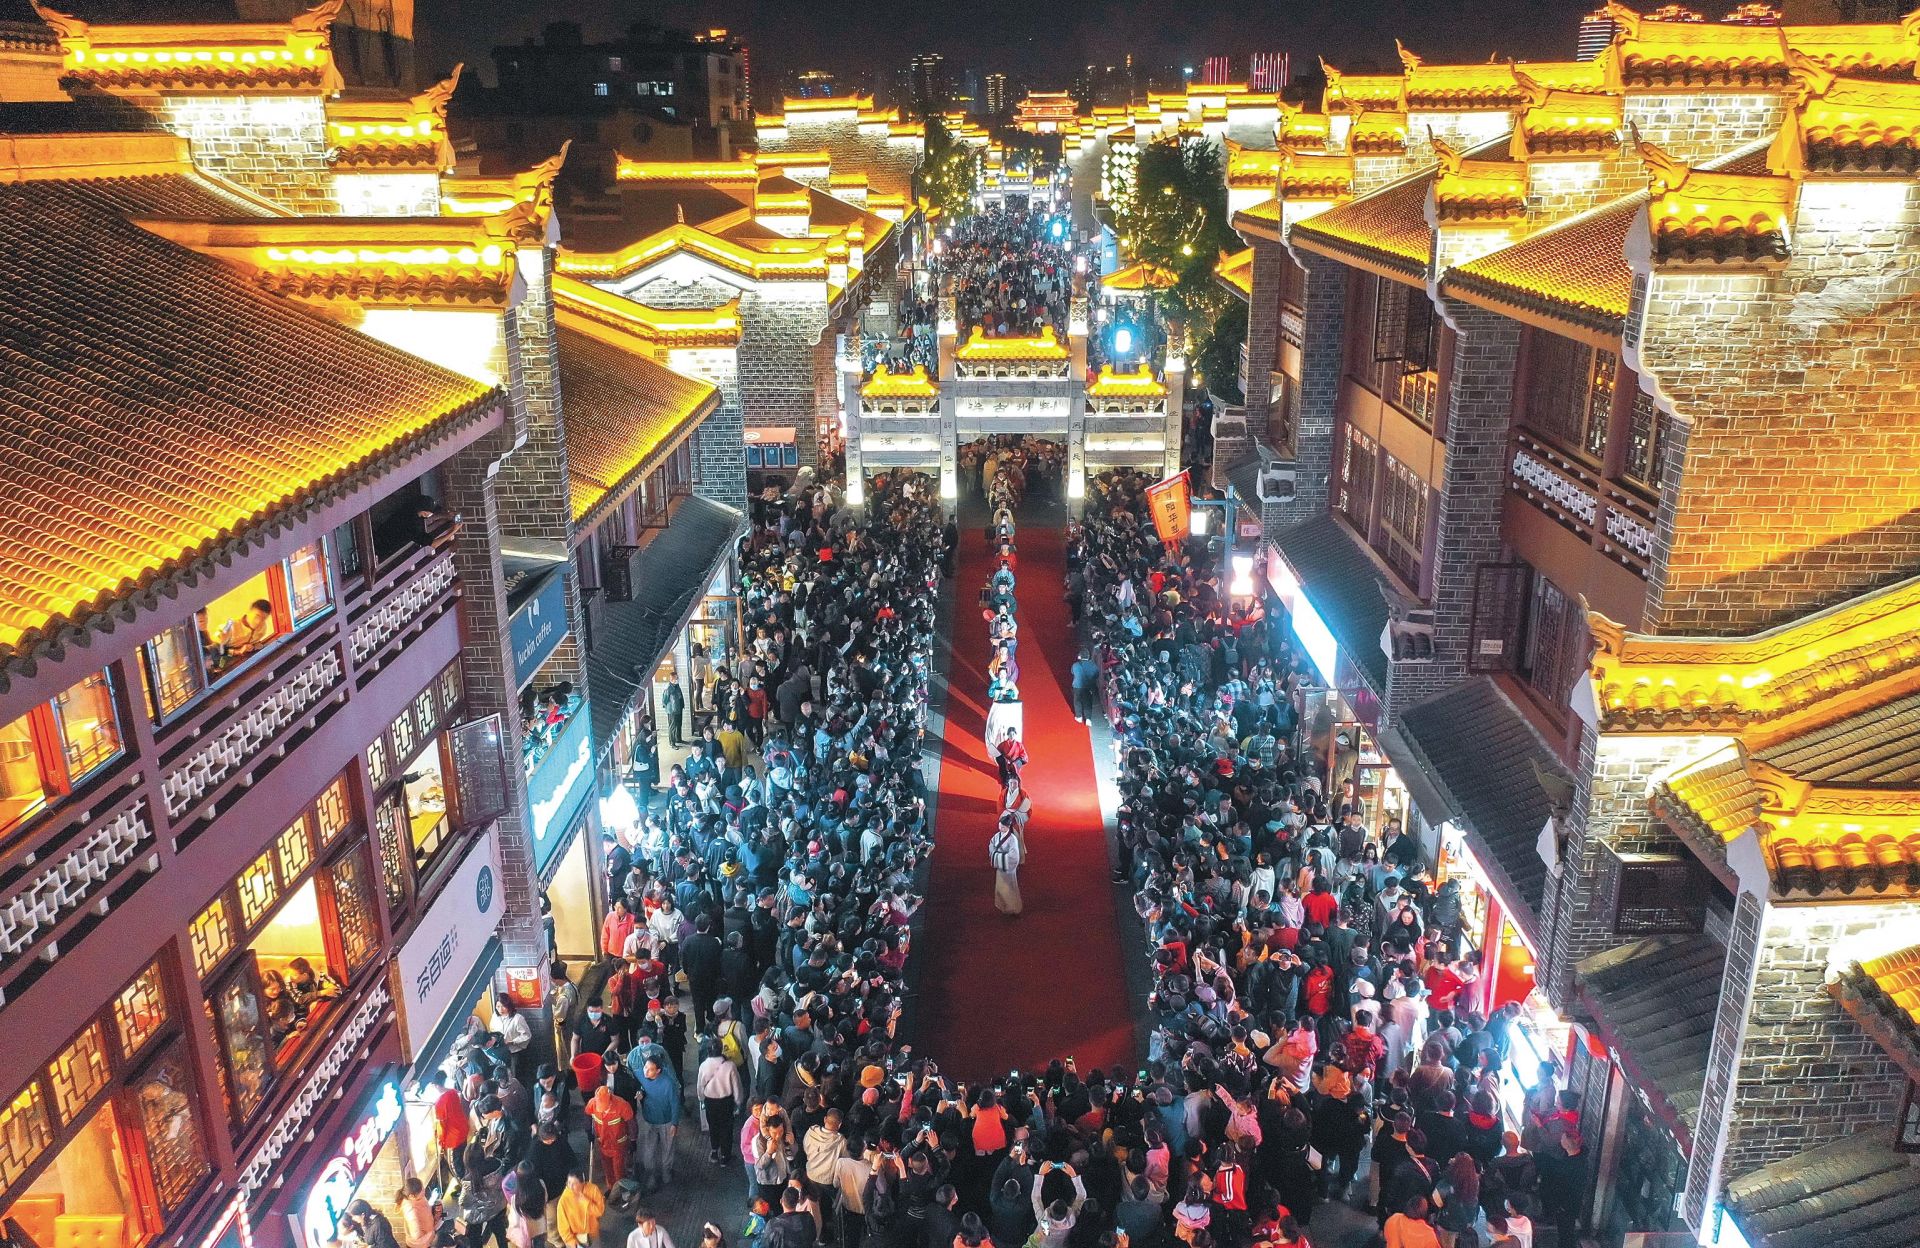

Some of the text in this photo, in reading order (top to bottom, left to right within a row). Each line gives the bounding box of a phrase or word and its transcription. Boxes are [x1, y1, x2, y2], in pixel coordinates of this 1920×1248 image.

[517, 621, 552, 667] luckin coffee
[416, 934, 452, 1004] 茶百道
